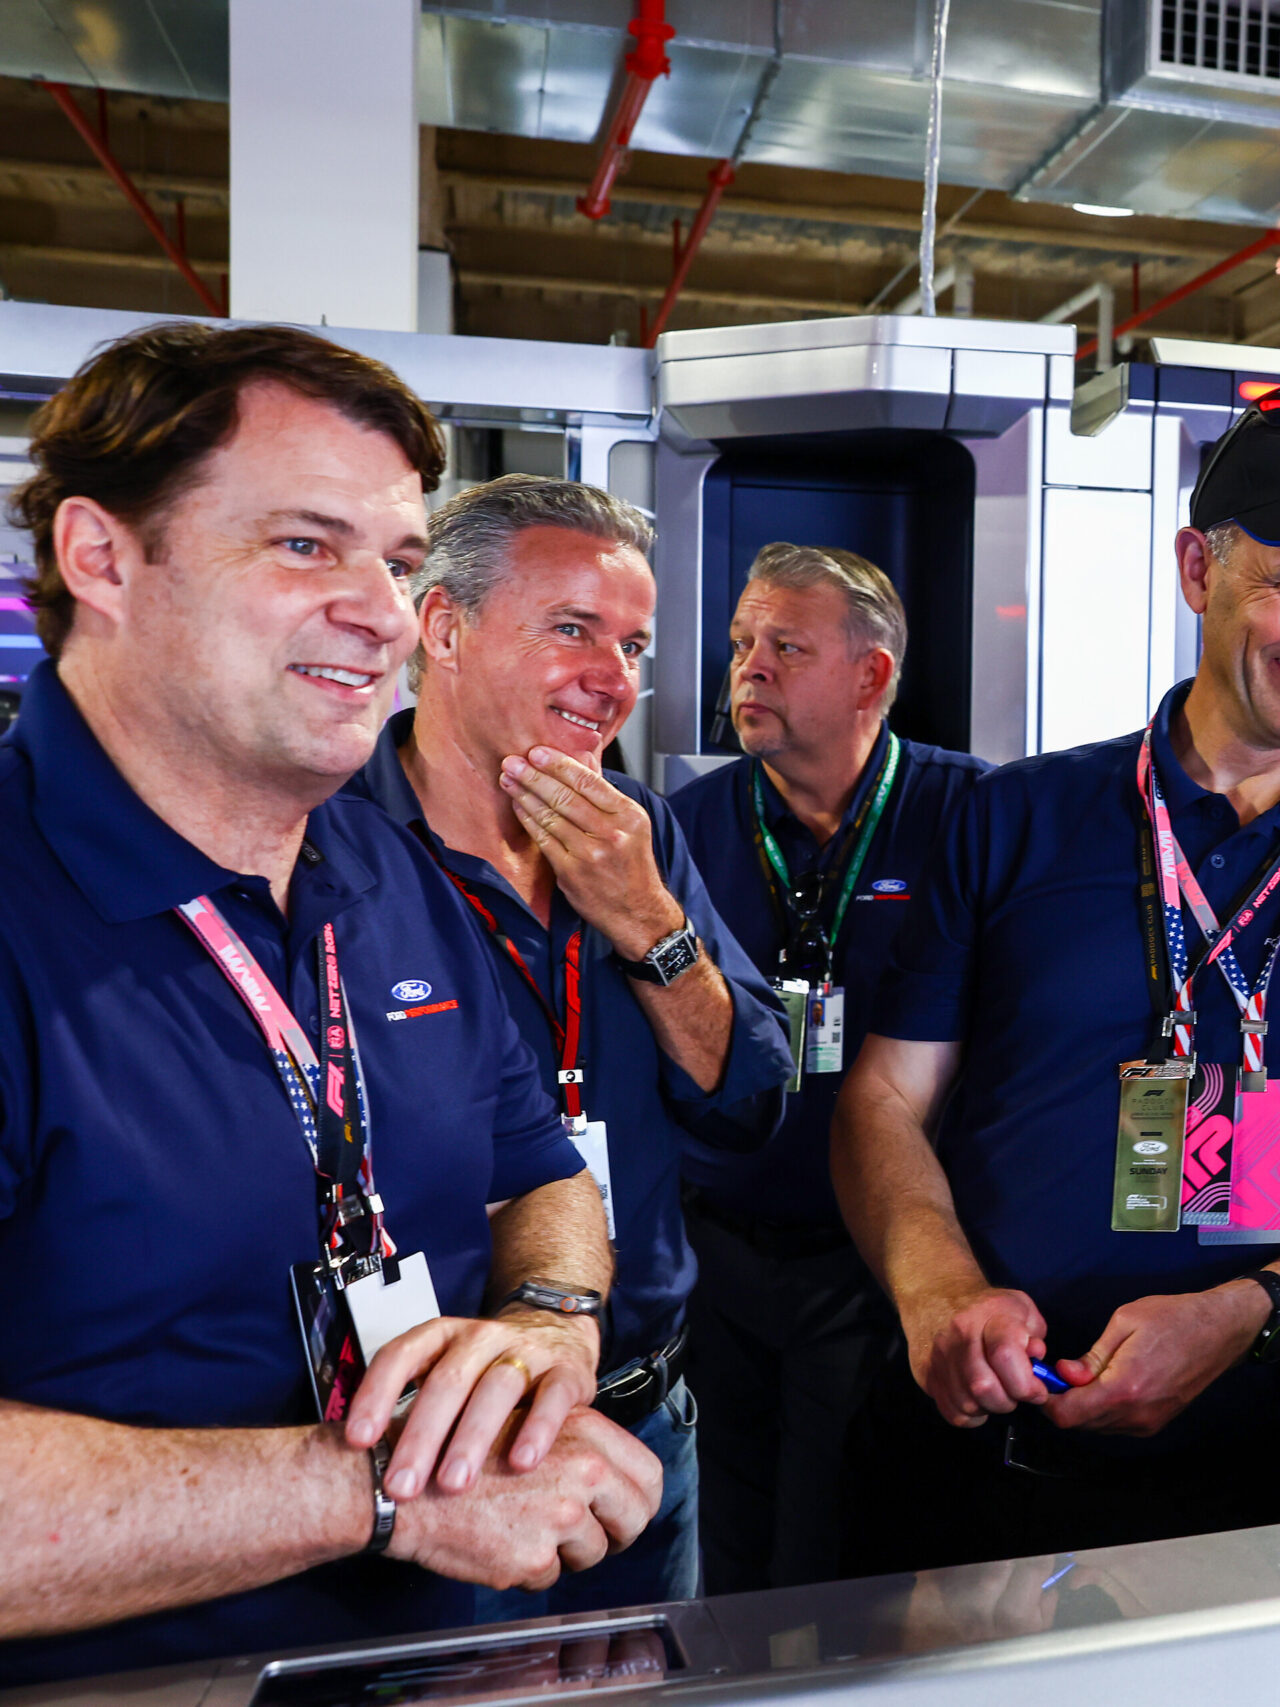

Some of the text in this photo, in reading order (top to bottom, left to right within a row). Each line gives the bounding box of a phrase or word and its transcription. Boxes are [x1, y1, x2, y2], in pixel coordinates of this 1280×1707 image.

[1158, 830, 1176, 879] MIAMI
[220, 945, 271, 1012] MIAMI
[1129, 1167, 1168, 1175] SUNDAY
